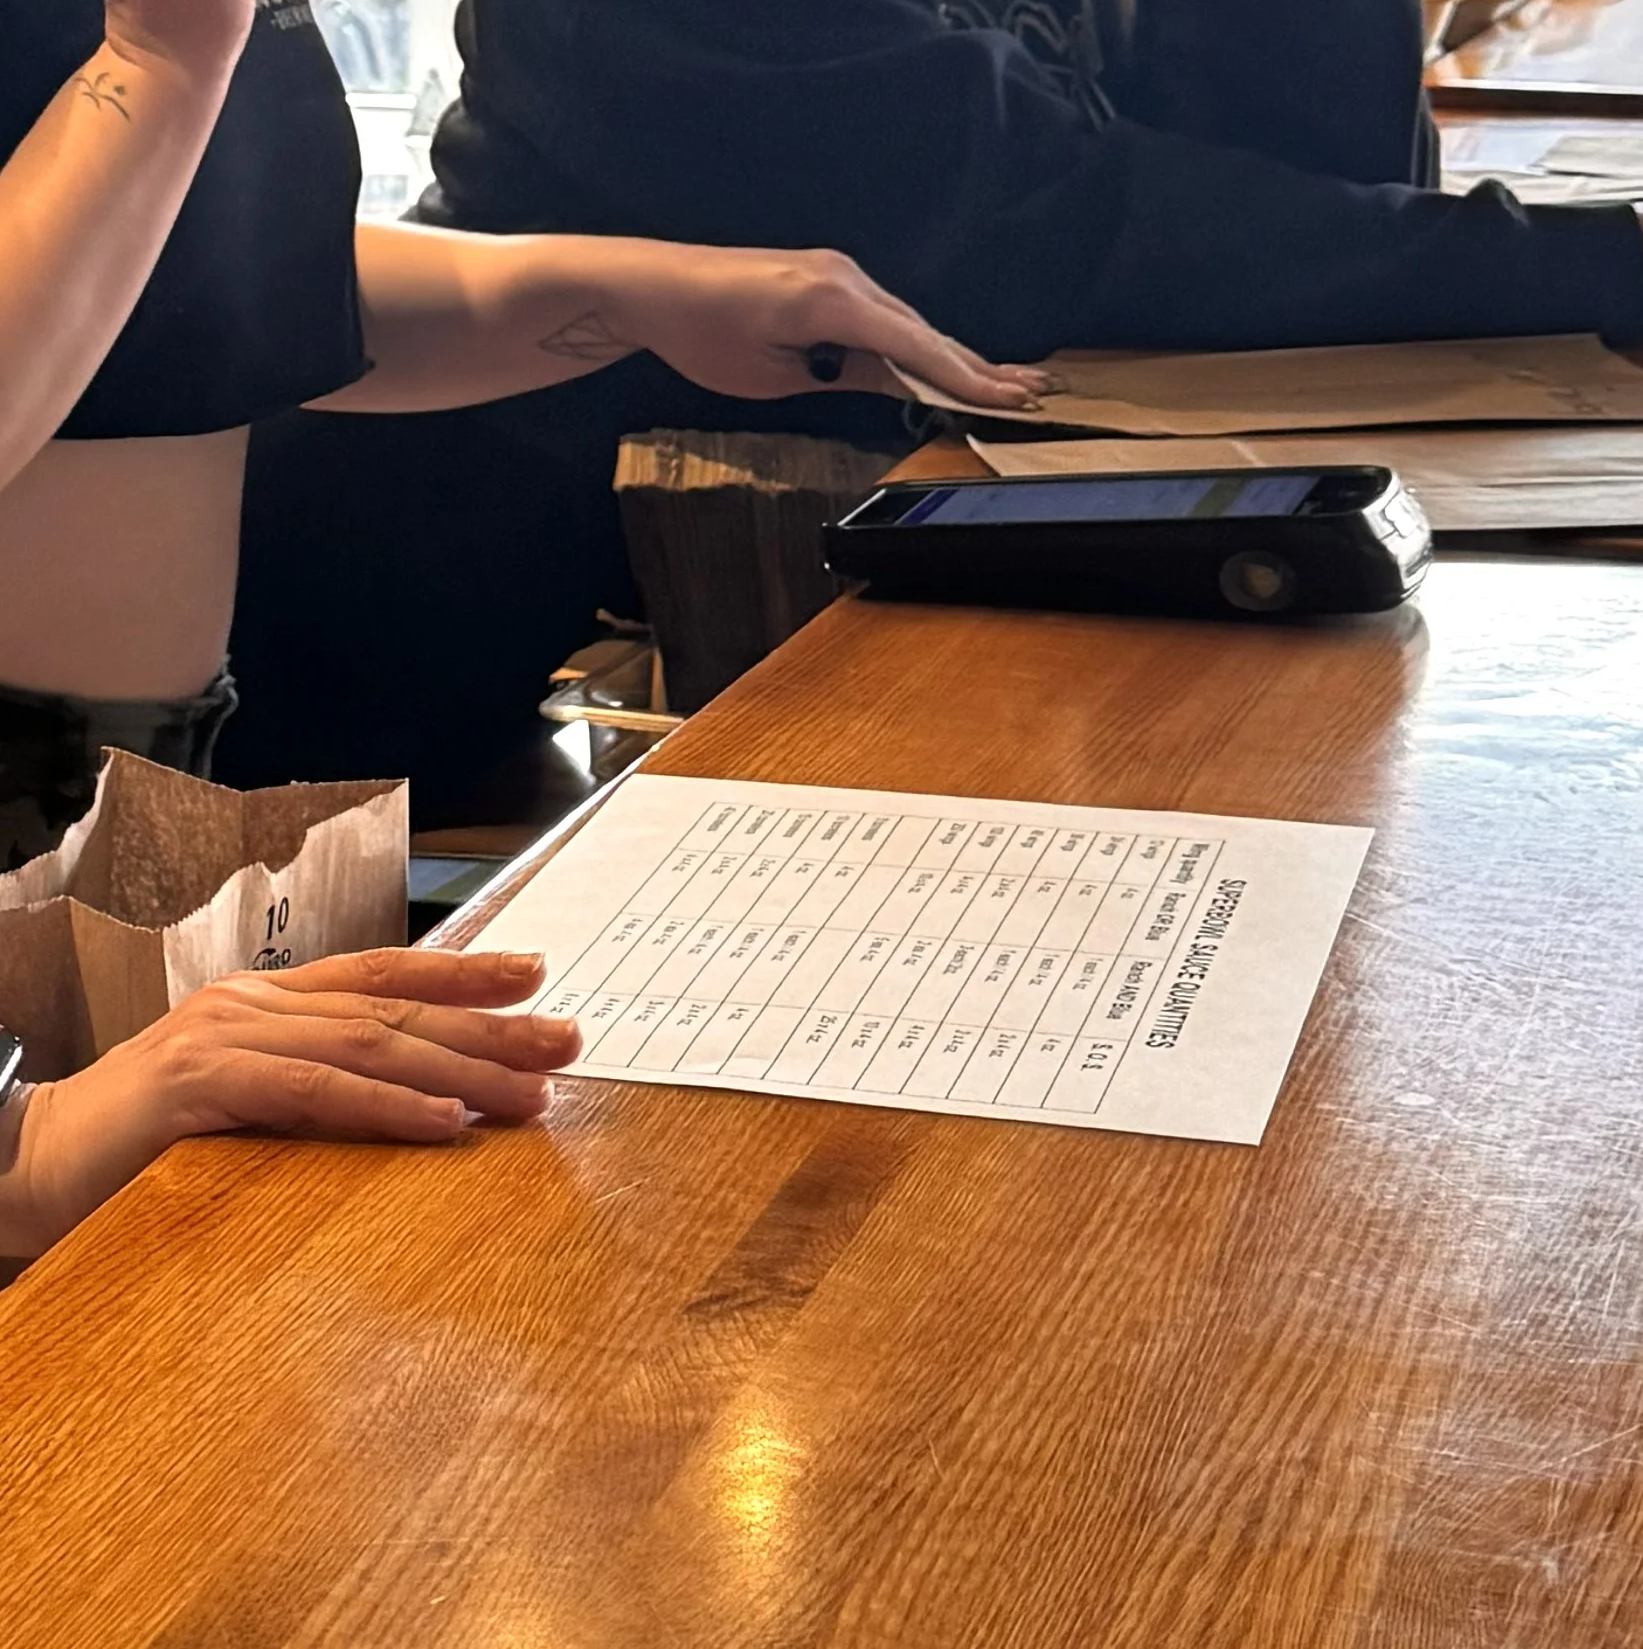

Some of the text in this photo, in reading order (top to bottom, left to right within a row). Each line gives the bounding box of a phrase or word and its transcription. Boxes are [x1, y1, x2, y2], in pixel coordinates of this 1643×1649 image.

[1180, 843, 1210, 858] Wing
[267, 896, 289, 941] 10
[1144, 892, 1186, 941] Ranch OR Blue
[1144, 878, 1246, 1048] SUPERBOWL SAUCE QUANTITIES
[1105, 960, 1152, 1019] Ranch AND Blue
